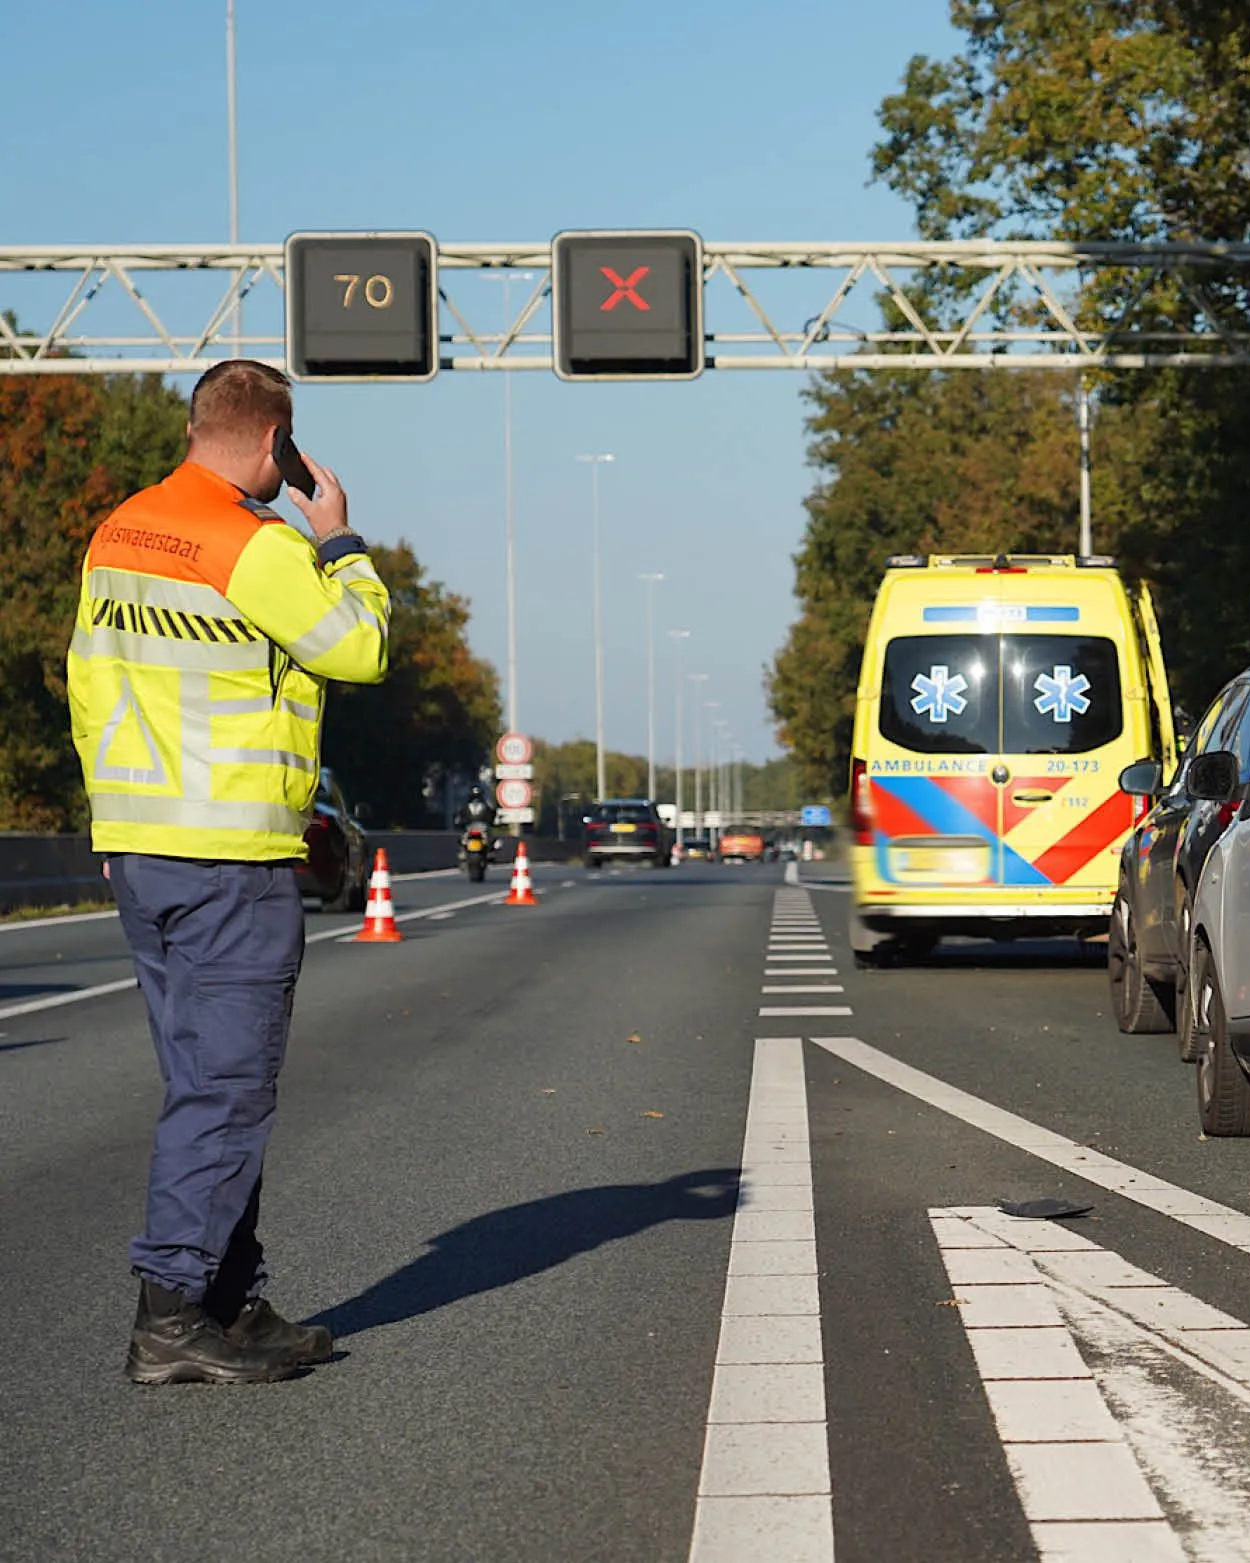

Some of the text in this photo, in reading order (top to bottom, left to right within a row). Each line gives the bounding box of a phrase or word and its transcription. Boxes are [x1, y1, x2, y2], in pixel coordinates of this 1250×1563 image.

[333, 274, 394, 309] 70
[871, 759, 987, 773] AMBULANCE
[1046, 759, 1100, 773] 20-173
